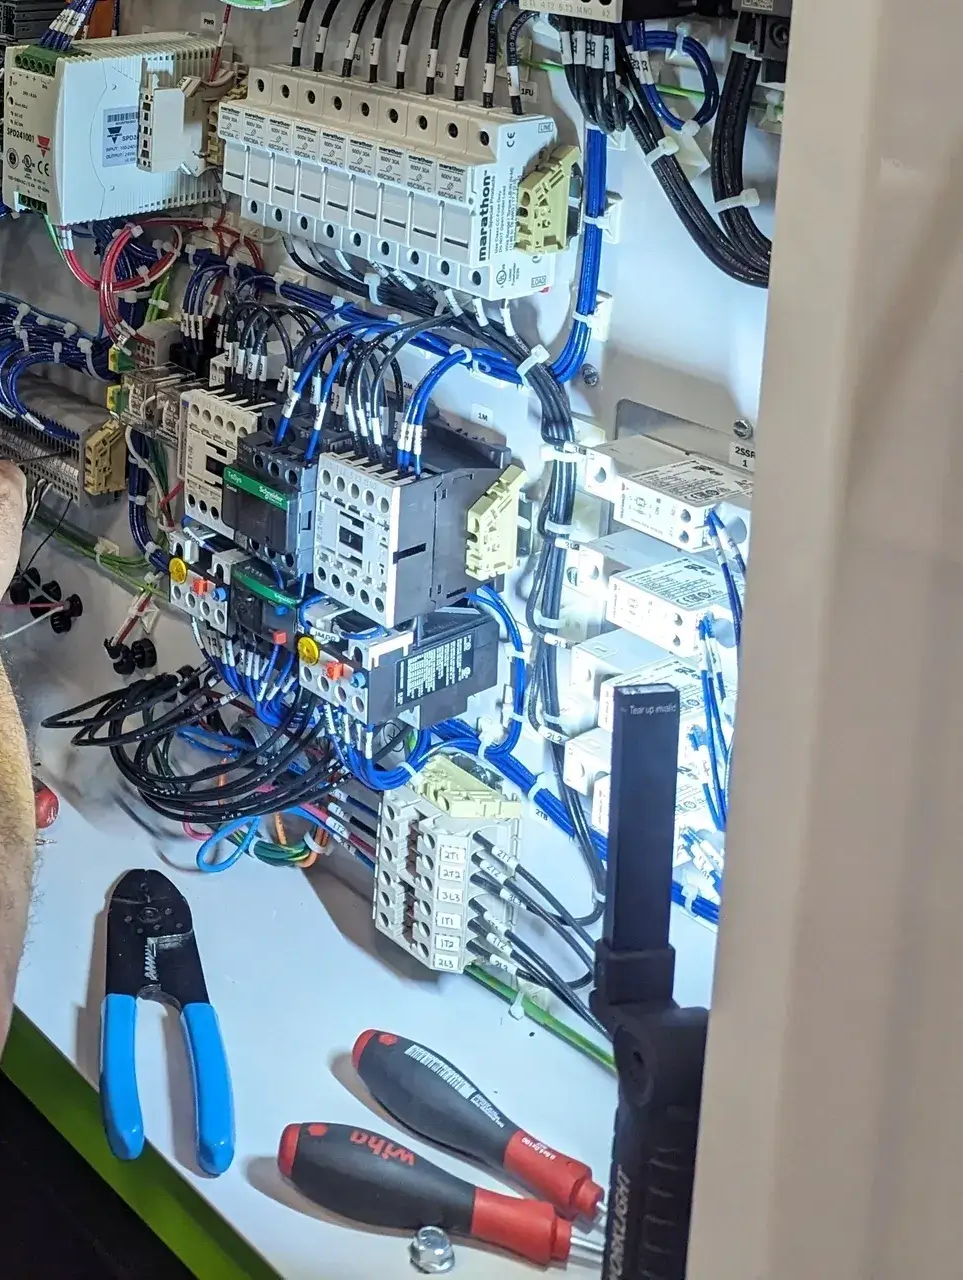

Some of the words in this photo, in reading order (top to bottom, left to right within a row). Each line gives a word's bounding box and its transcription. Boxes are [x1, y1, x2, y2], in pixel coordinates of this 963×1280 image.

[521, 87, 534, 96] 1FU
[6, 128, 34, 143] SPD241001
[350, 139, 374, 148] marathon
[378, 146, 404, 156] marathon
[408, 154, 434, 164] marathon
[438, 162, 465, 173] marathon
[478, 175, 491, 262] marathon
[403, 382, 412, 390] 2M
[259, 486, 284, 502] Schneider
[630, 705, 644, 714] Tear
[644, 706, 655, 715] up
[535, 808, 548, 820] 2TB
[497, 850, 511, 862] 2T1
[443, 870, 461, 878] 2T2
[486, 863, 501, 877] 2T2
[442, 892, 460, 902] 3L3
[442, 916, 454, 926] 1T1
[440, 938, 454, 948] 1T2
[493, 936, 508, 950] 1T2
[438, 958, 454, 968] 2L3
[349, 1130, 415, 1167] wiha
